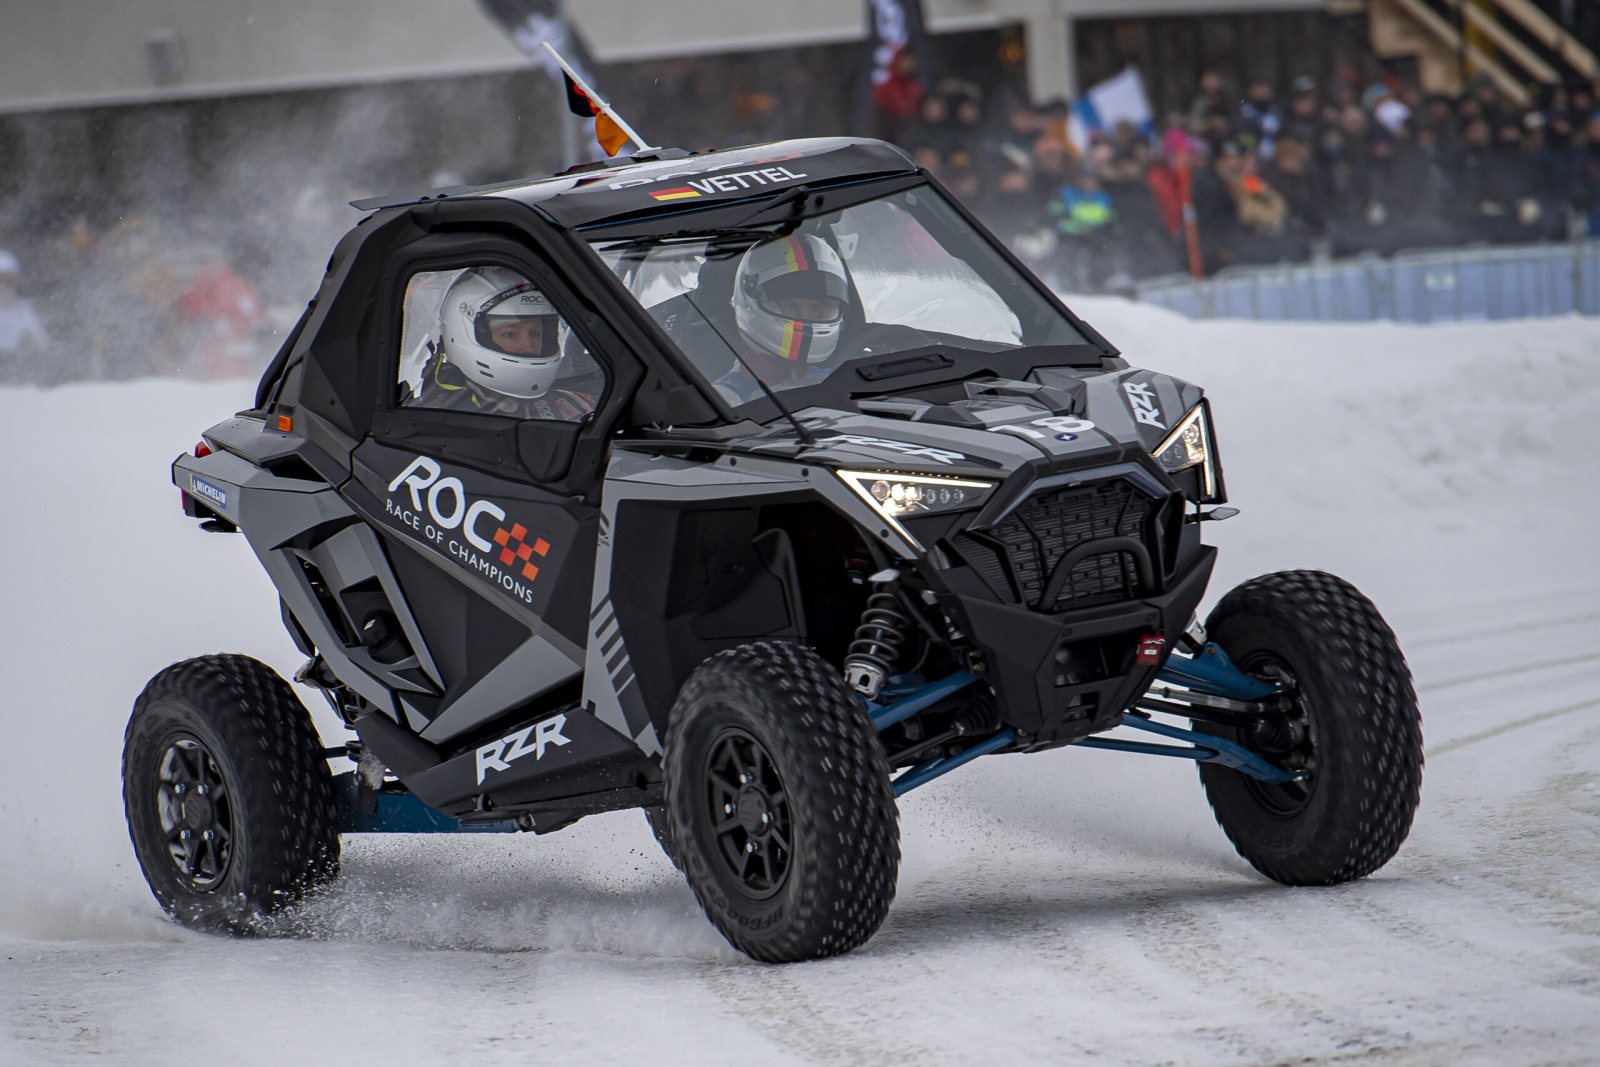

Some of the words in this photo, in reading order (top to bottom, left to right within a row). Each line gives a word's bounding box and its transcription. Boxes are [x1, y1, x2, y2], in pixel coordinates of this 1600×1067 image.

[688, 166, 807, 194] VETTEL
[520, 295, 544, 303] ROC
[1123, 382, 1168, 430] RZR
[817, 434, 966, 465] RZR
[196, 479, 226, 504] MICHELIN
[388, 455, 506, 553] ROC
[386, 499, 420, 531] RACE
[425, 525, 443, 544] OF
[449, 540, 533, 603] CHAMPIONS
[476, 713, 572, 786] RZR
